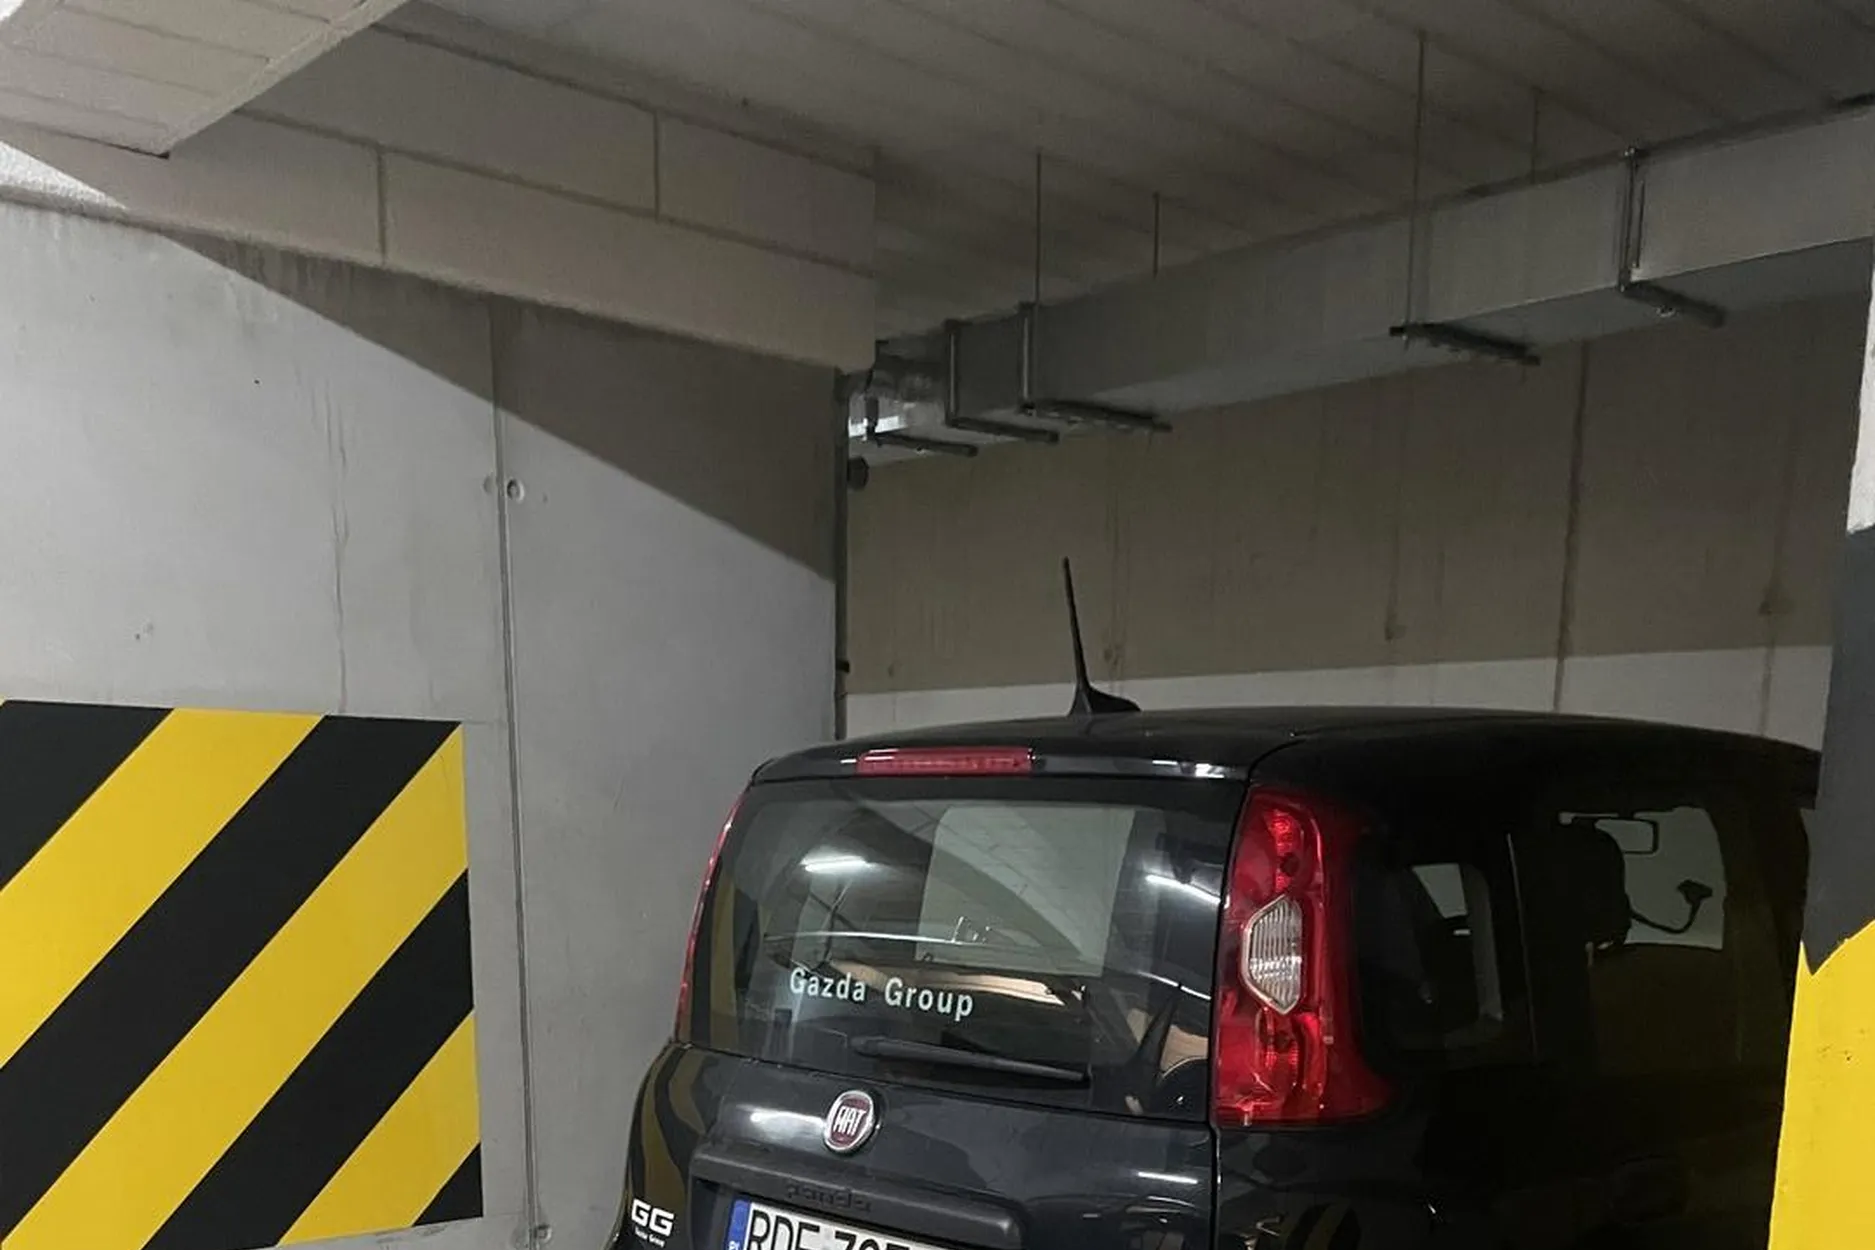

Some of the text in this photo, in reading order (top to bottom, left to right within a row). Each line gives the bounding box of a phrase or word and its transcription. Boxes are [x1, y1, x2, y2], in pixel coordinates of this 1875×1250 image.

[789, 966, 973, 1022] Gazda Group
[832, 1105, 868, 1137] FIAT
[631, 1198, 675, 1237] GG
